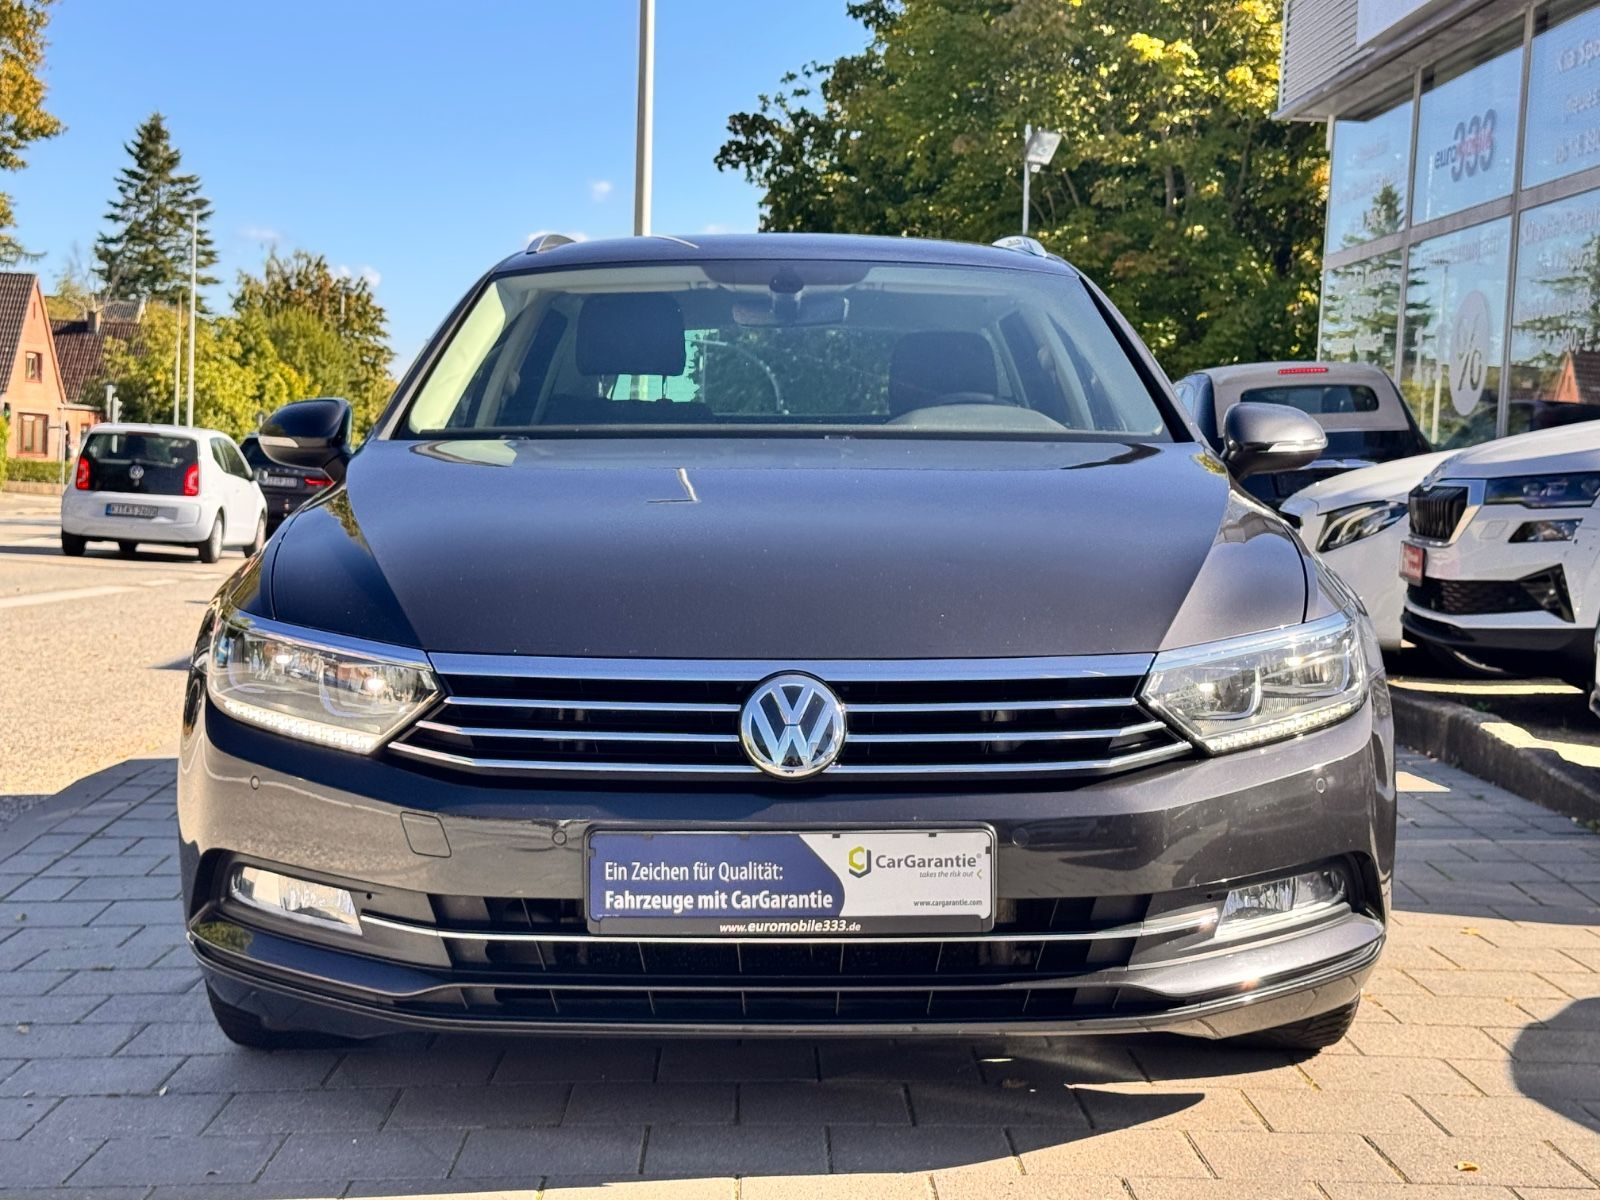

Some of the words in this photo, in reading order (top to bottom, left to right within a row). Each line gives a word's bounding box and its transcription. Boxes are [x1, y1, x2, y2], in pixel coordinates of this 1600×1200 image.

[1451, 108, 1498, 182] 333
[875, 853, 977, 869] CarGarantie
[604, 861, 628, 881] Ein
[631, 861, 689, 881] Zeichen
[693, 861, 715, 881] für
[718, 861, 783, 883] Qualität:
[919, 870, 937, 879] takes
[938, 870, 949, 878] the
[950, 870, 962, 878] risk
[604, 890, 694, 914] Fahrzeuge
[697, 890, 728, 910] mit
[731, 890, 833, 910] CarGarantie
[913, 898, 983, 908] www.cargarantie.com
[719, 919, 862, 934] www.euromobile333.de
